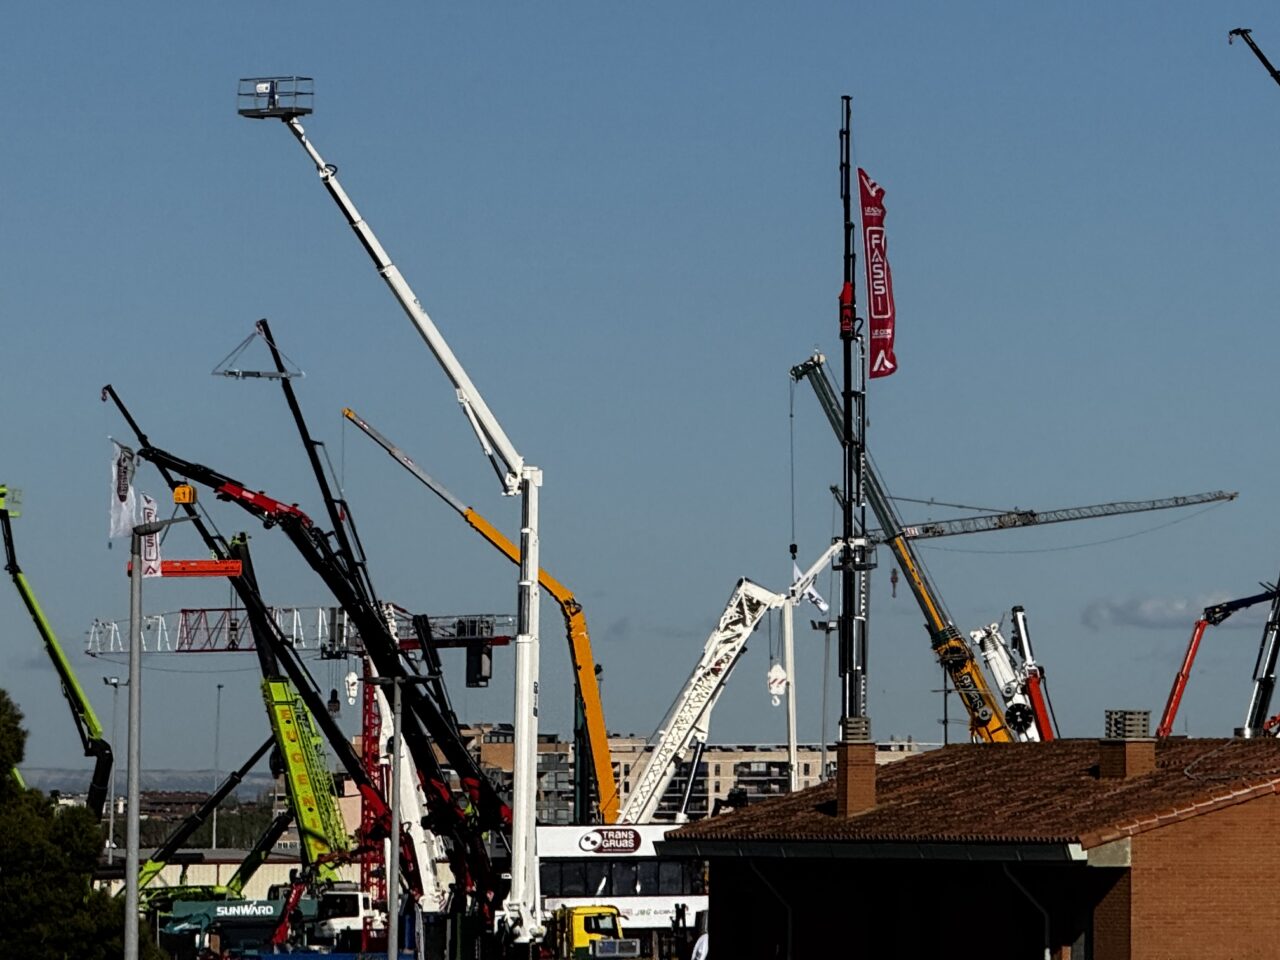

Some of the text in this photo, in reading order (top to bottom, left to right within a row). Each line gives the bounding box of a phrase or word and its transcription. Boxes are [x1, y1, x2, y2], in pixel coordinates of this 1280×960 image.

[871, 234, 886, 312] FASSI
[146, 512, 154, 556] FSI
[280, 709, 325, 851] EUGENIO
[216, 902, 274, 916] SUNWARD
